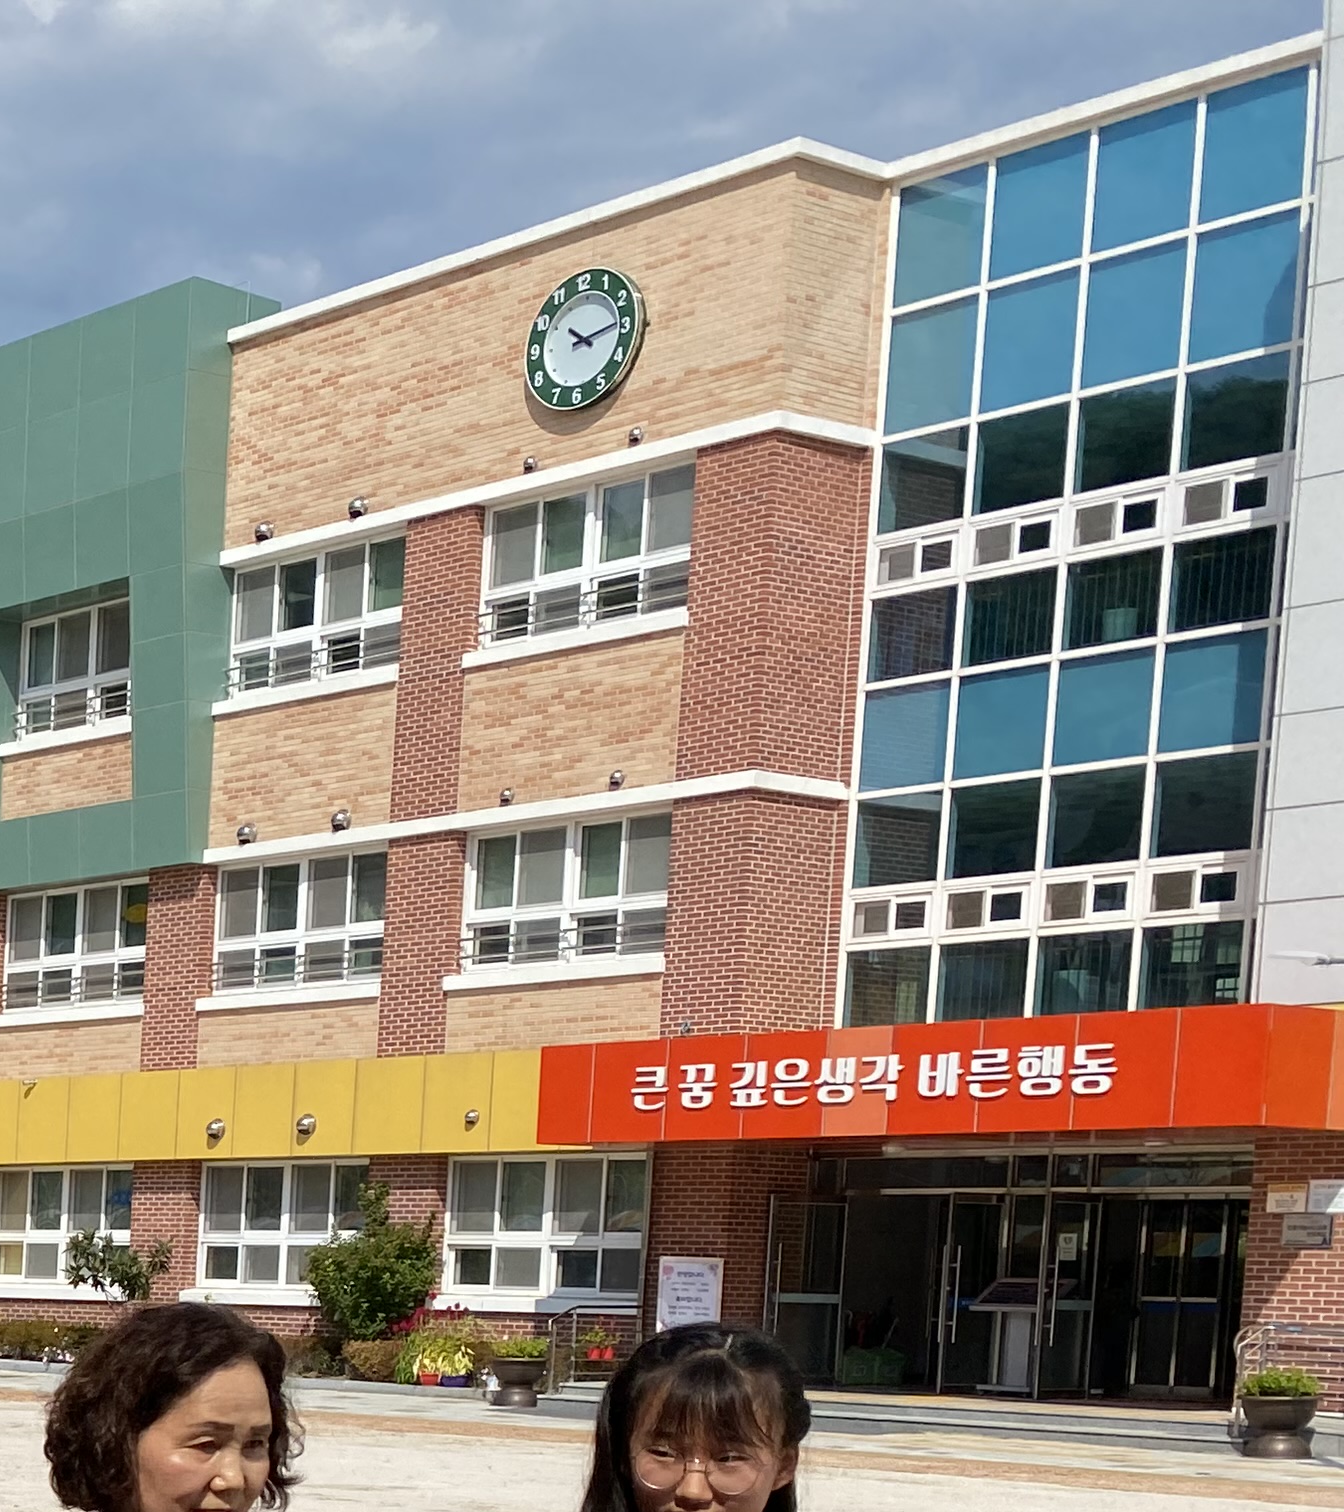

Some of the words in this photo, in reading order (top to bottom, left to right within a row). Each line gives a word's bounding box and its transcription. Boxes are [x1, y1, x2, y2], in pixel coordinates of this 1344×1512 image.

[576, 274, 591, 291] 12
[602, 274, 609, 290] 1
[552, 288, 566, 305] 11
[617, 290, 627, 306] 2
[535, 315, 550, 331] 10
[621, 317, 630, 333] 3
[530, 344, 540, 360] 9
[613, 346, 623, 362] 4
[534, 371, 544, 387] 8
[596, 373, 605, 390] 5
[551, 387, 561, 404] 7
[572, 388, 582, 403] 6
[630, 1065, 669, 1111] 큰
[678, 1063, 719, 1109] 꿈
[916, 1043, 1118, 1100] 바른행동
